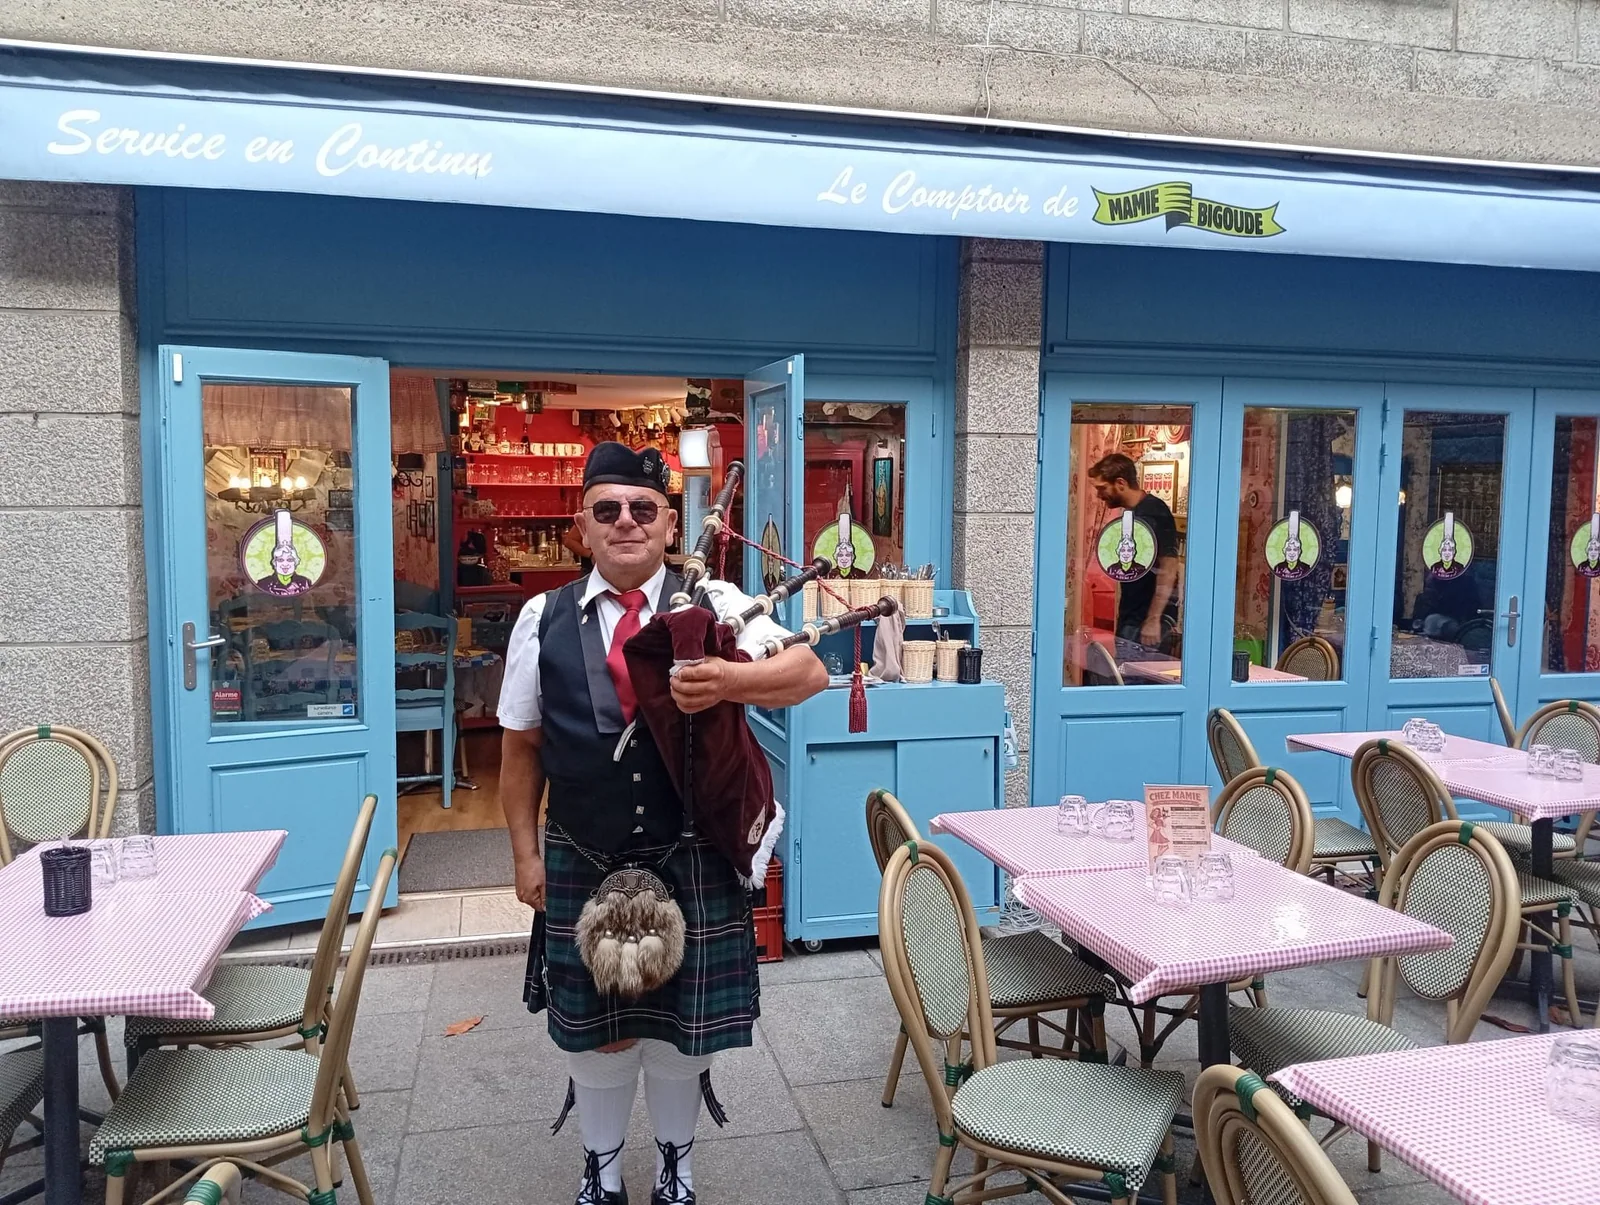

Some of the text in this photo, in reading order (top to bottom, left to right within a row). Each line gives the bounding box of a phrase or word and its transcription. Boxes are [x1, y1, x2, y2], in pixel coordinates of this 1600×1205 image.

[47, 109, 493, 178] Service en Continu
[816, 165, 1264, 236] Le Comptoir de MAMIE BIGOUDE
[1149, 790, 1202, 801] CHEZ MAMIE
